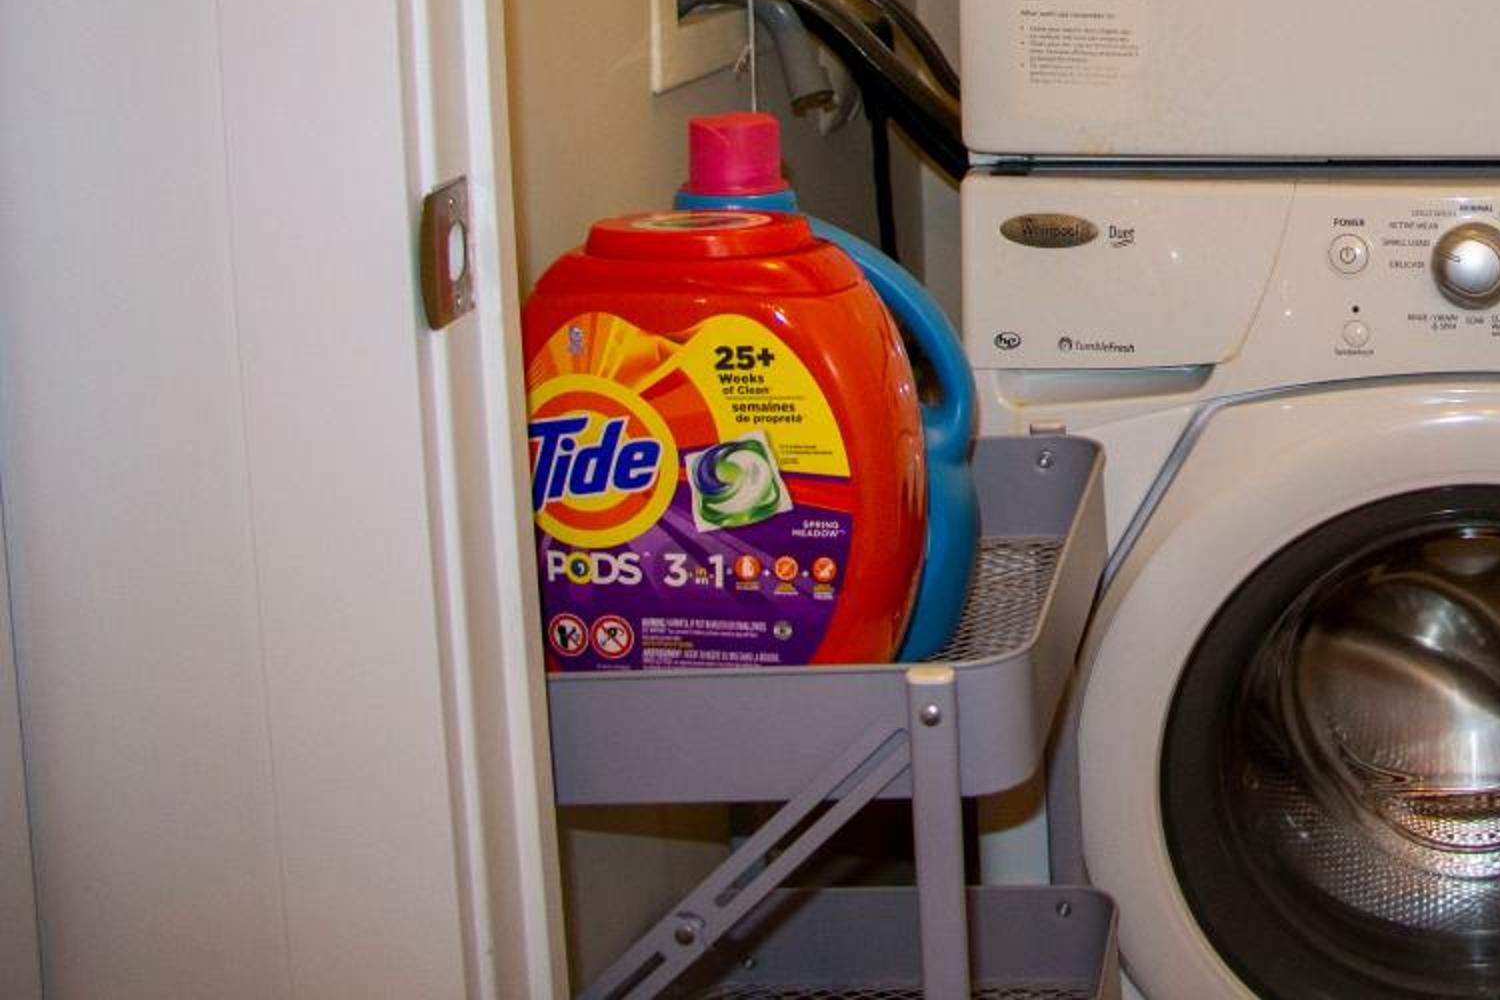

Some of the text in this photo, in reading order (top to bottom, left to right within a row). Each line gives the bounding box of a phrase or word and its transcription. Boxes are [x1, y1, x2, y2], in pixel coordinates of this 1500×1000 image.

[714, 345, 775, 371] 25+
[717, 373, 765, 385] Weeks
[737, 385, 769, 395] Clean
[732, 401, 796, 413] semaines
[735, 414, 750, 423] de
[528, 414, 662, 514] Tide
[546, 550, 643, 586] PODS
